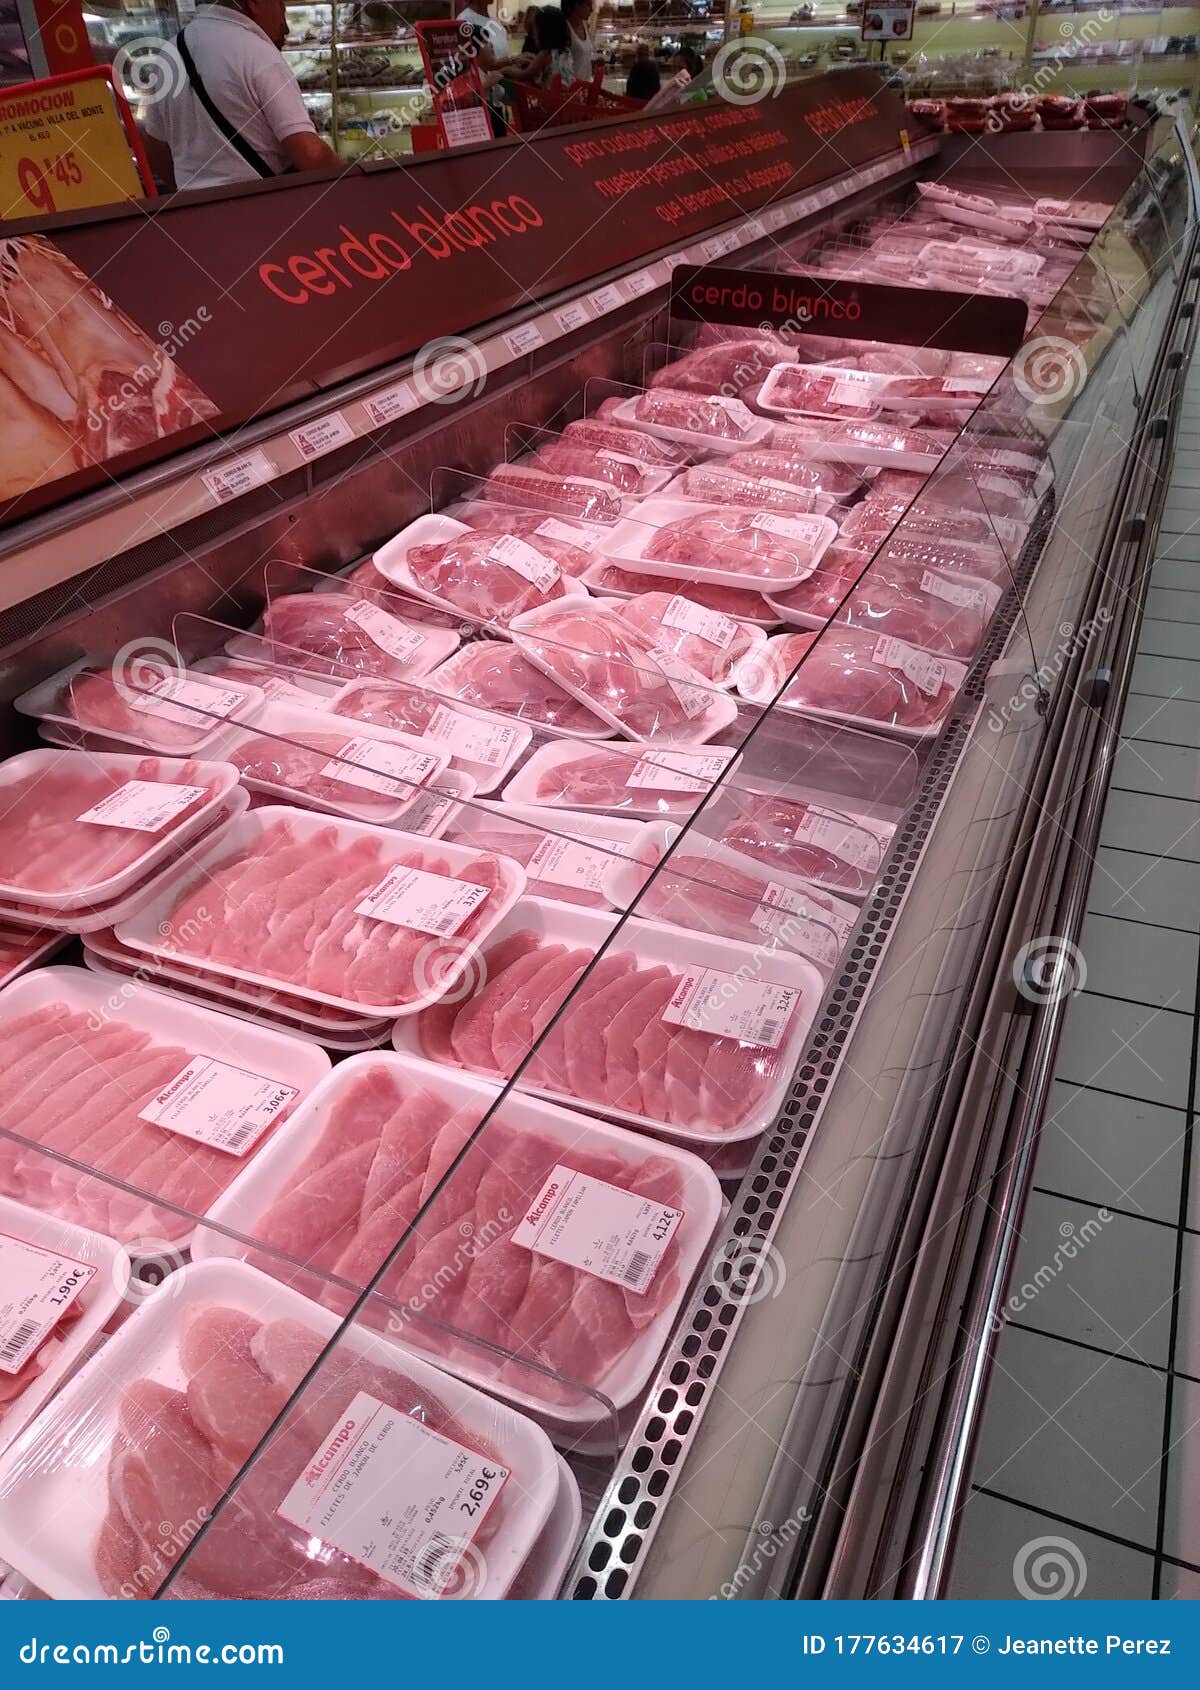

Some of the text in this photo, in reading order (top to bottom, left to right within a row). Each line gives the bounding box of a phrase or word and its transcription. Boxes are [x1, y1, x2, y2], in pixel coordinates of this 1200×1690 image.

[0, 91, 75, 120] ROMOCION
[564, 142, 603, 168] para
[595, 168, 650, 198] nuestro
[655, 203, 685, 226] que
[258, 195, 544, 305] cerdo blanco
[691, 284, 862, 320] cerdo blanco
[463, 888, 484, 907] 3,77€
[671, 977, 694, 1008] Alcampo
[156, 1070, 194, 1104] Alcampo
[263, 1089, 290, 1114] 3,06€
[526, 1183, 560, 1227] Alcampo
[652, 1210, 675, 1241] 4,12€
[50, 1268, 85, 1306] 1,90€
[304, 1420, 356, 1489] Alcampo
[331, 1440, 370, 1493] CERDO BLANCO
[453, 1454, 469, 1473] 5,95€
[319, 1492, 345, 1527] FILETES
[343, 1479, 354, 1491] DE
[368, 1442, 379, 1453] DE
[376, 1418, 395, 1441] CERDO
[460, 1466, 497, 1517] 2,69€
[423, 1494, 446, 1524] 0,452kg
